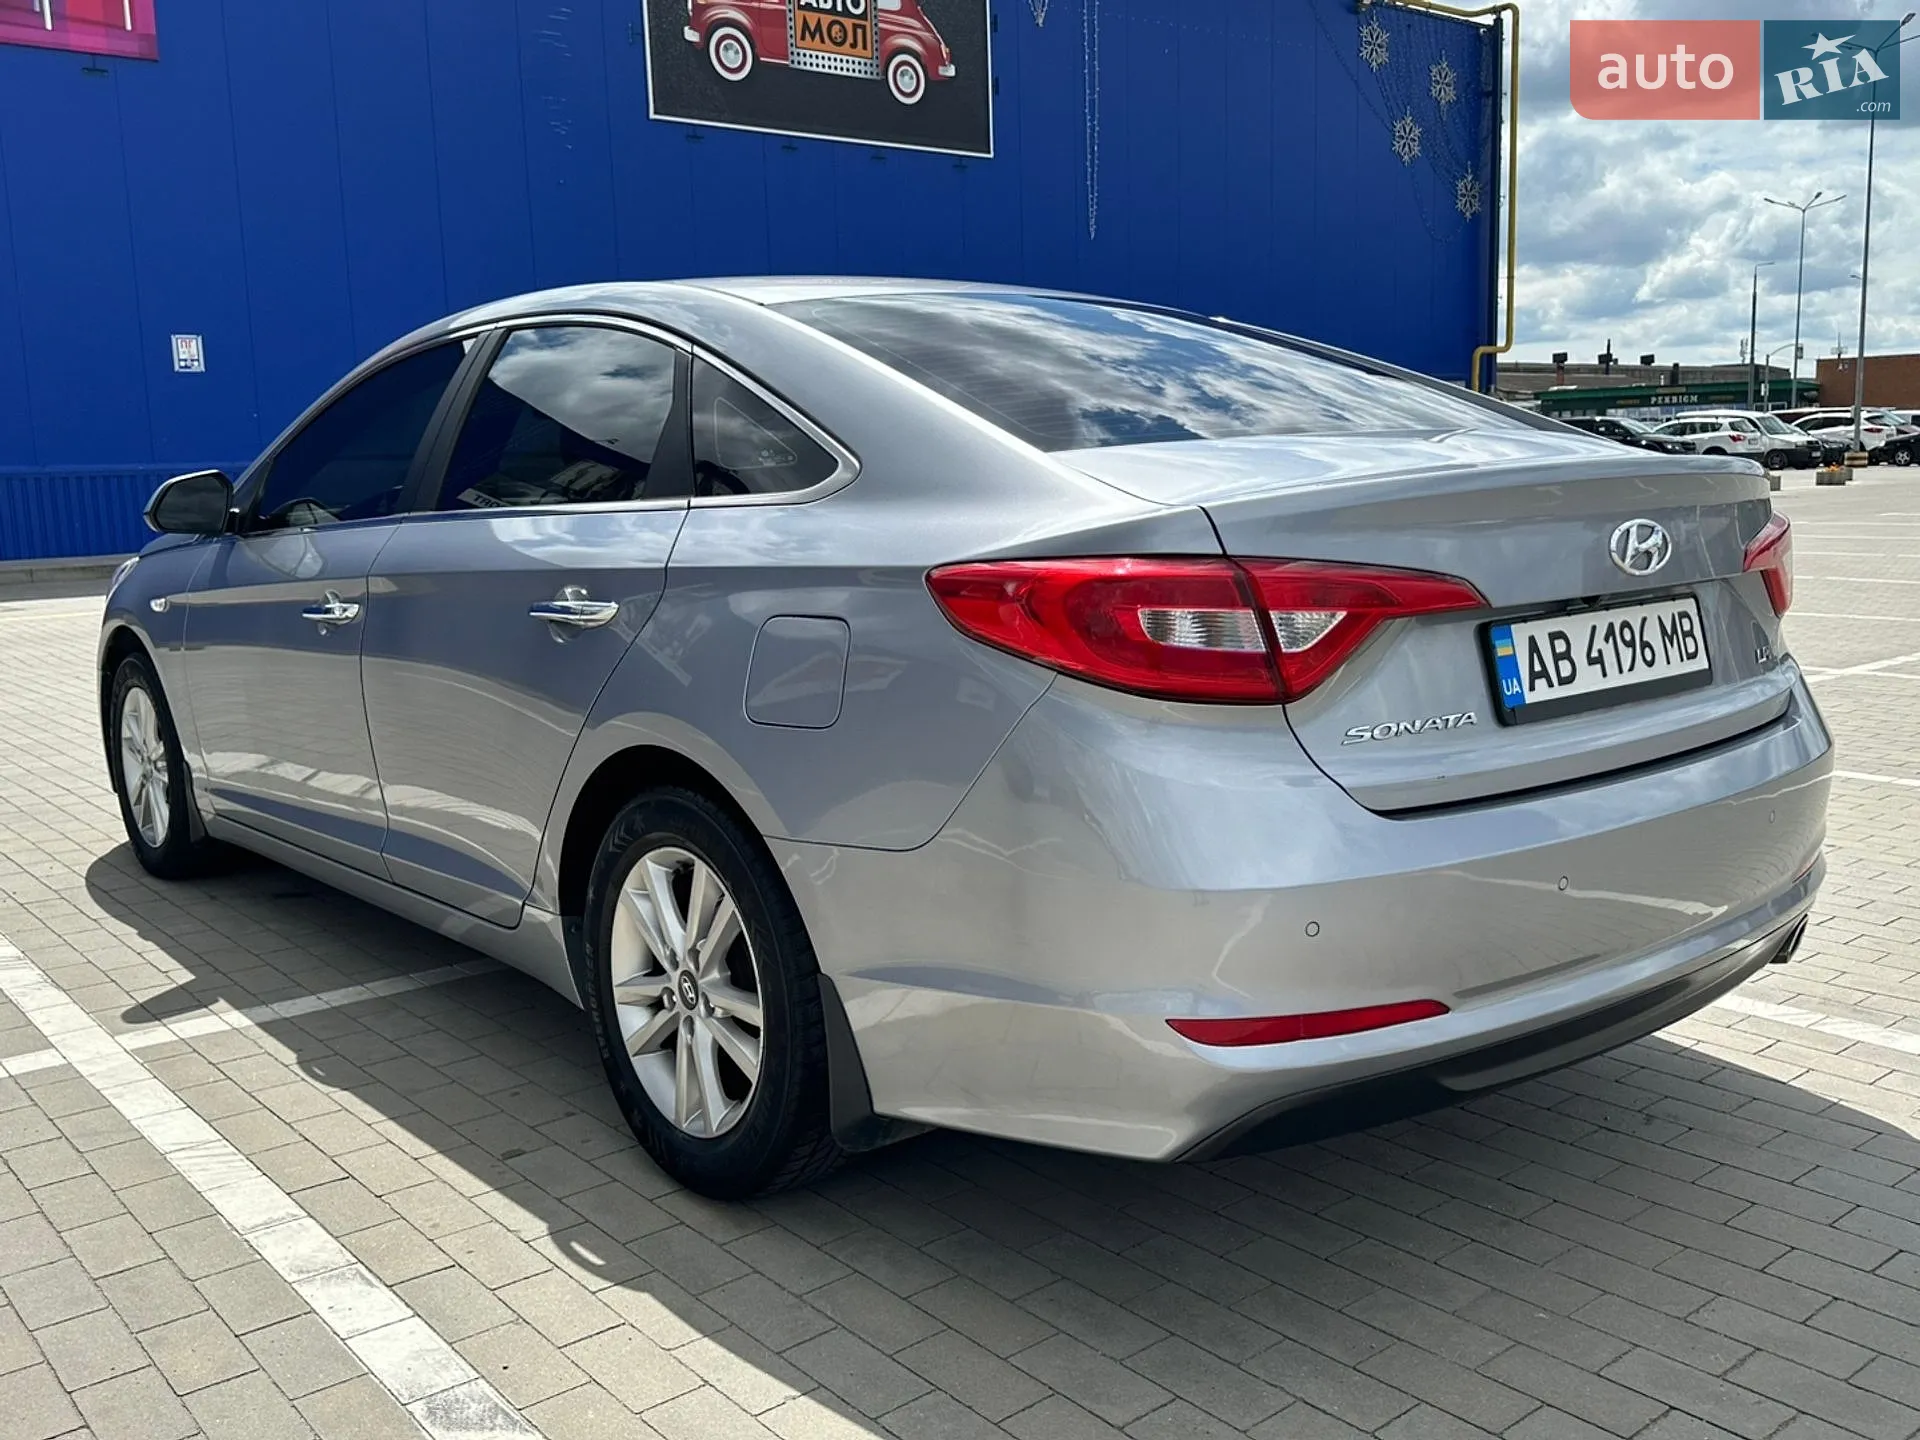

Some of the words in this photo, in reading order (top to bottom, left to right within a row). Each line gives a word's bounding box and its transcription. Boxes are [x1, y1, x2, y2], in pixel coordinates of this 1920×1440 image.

[800, 14, 868, 51] МОЛ
[1528, 630, 1577, 692] AB
[1586, 616, 1656, 678] 4196
[1657, 610, 1698, 665] MB
[1502, 678, 1521, 696] UA
[1341, 711, 1477, 745] SONATA
